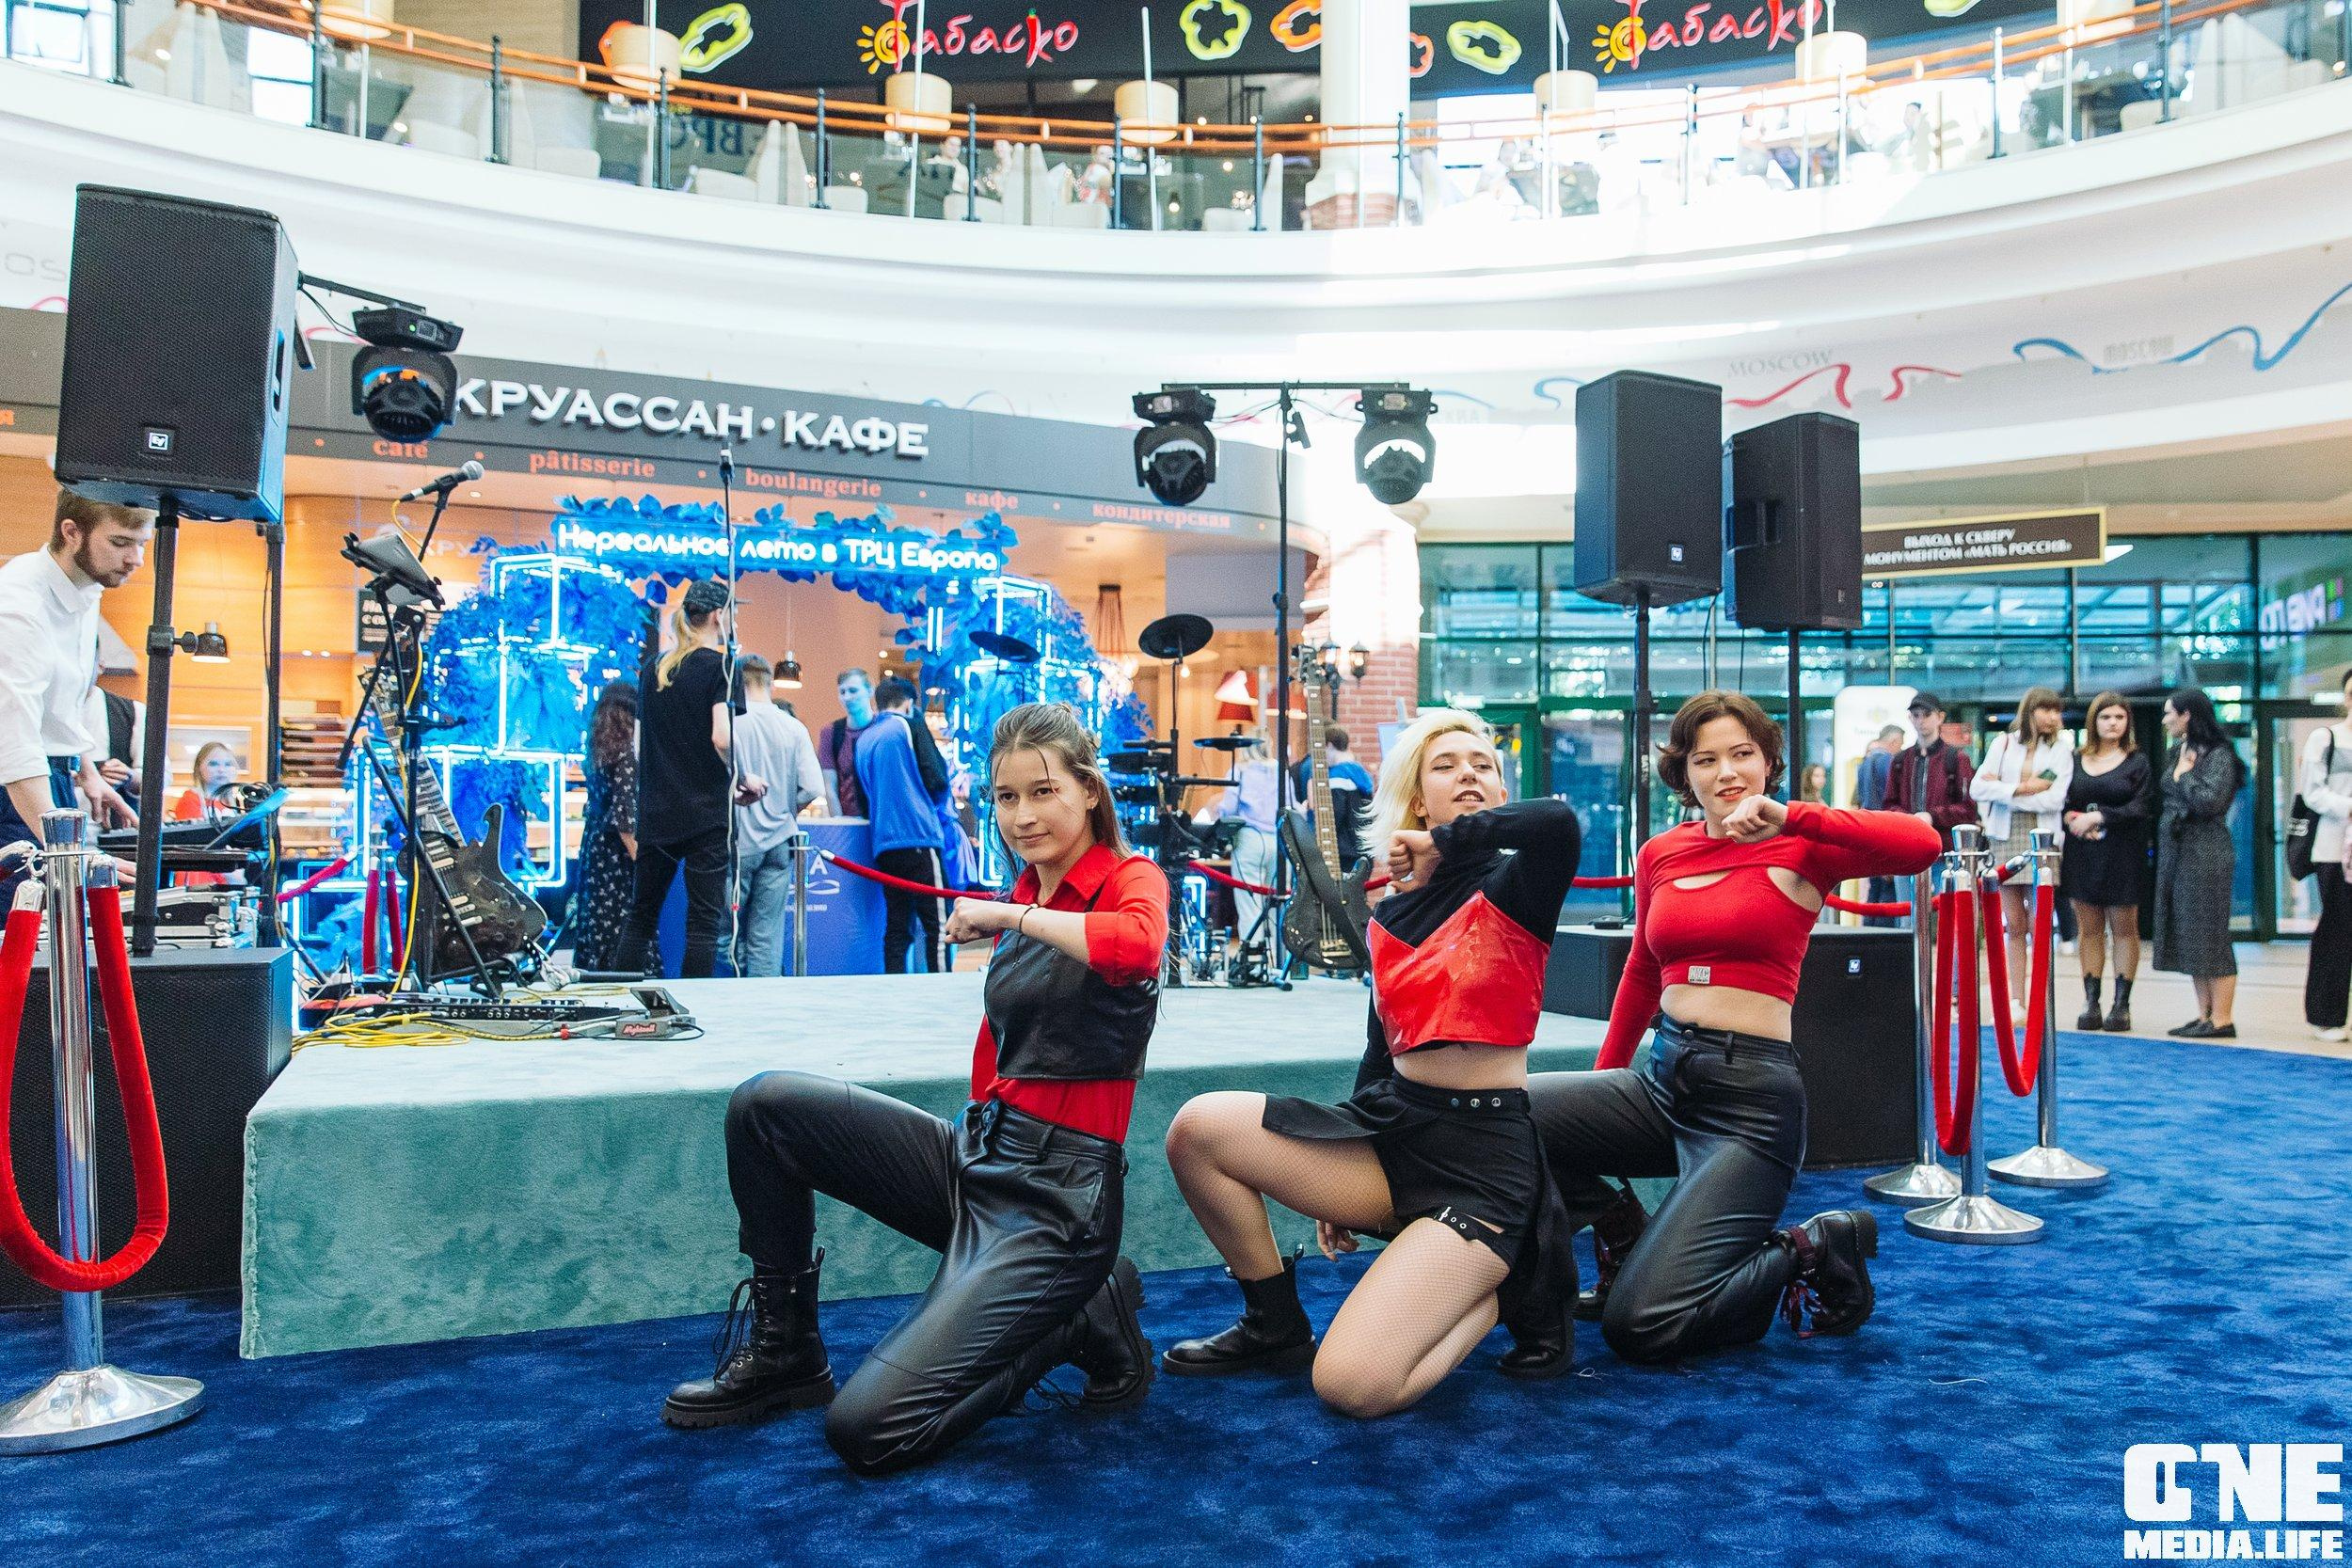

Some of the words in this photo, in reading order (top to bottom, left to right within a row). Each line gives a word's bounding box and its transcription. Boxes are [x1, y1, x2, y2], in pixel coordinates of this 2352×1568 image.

[455, 377, 753, 440] КРУАССАН
[784, 410, 930, 457] КАФЕ
[530, 450, 656, 478] pâtisserie
[745, 467, 882, 499] boulangerie
[965, 490, 1018, 512] кафе
[1092, 502, 1231, 529] кондитерская
[558, 523, 731, 557] Нереальное
[740, 540, 817, 562] лето
[821, 543, 837, 562] в
[843, 538, 896, 568] ТРЦ
[900, 542, 998, 573] Европа
[1954, 531, 1965, 546] К
